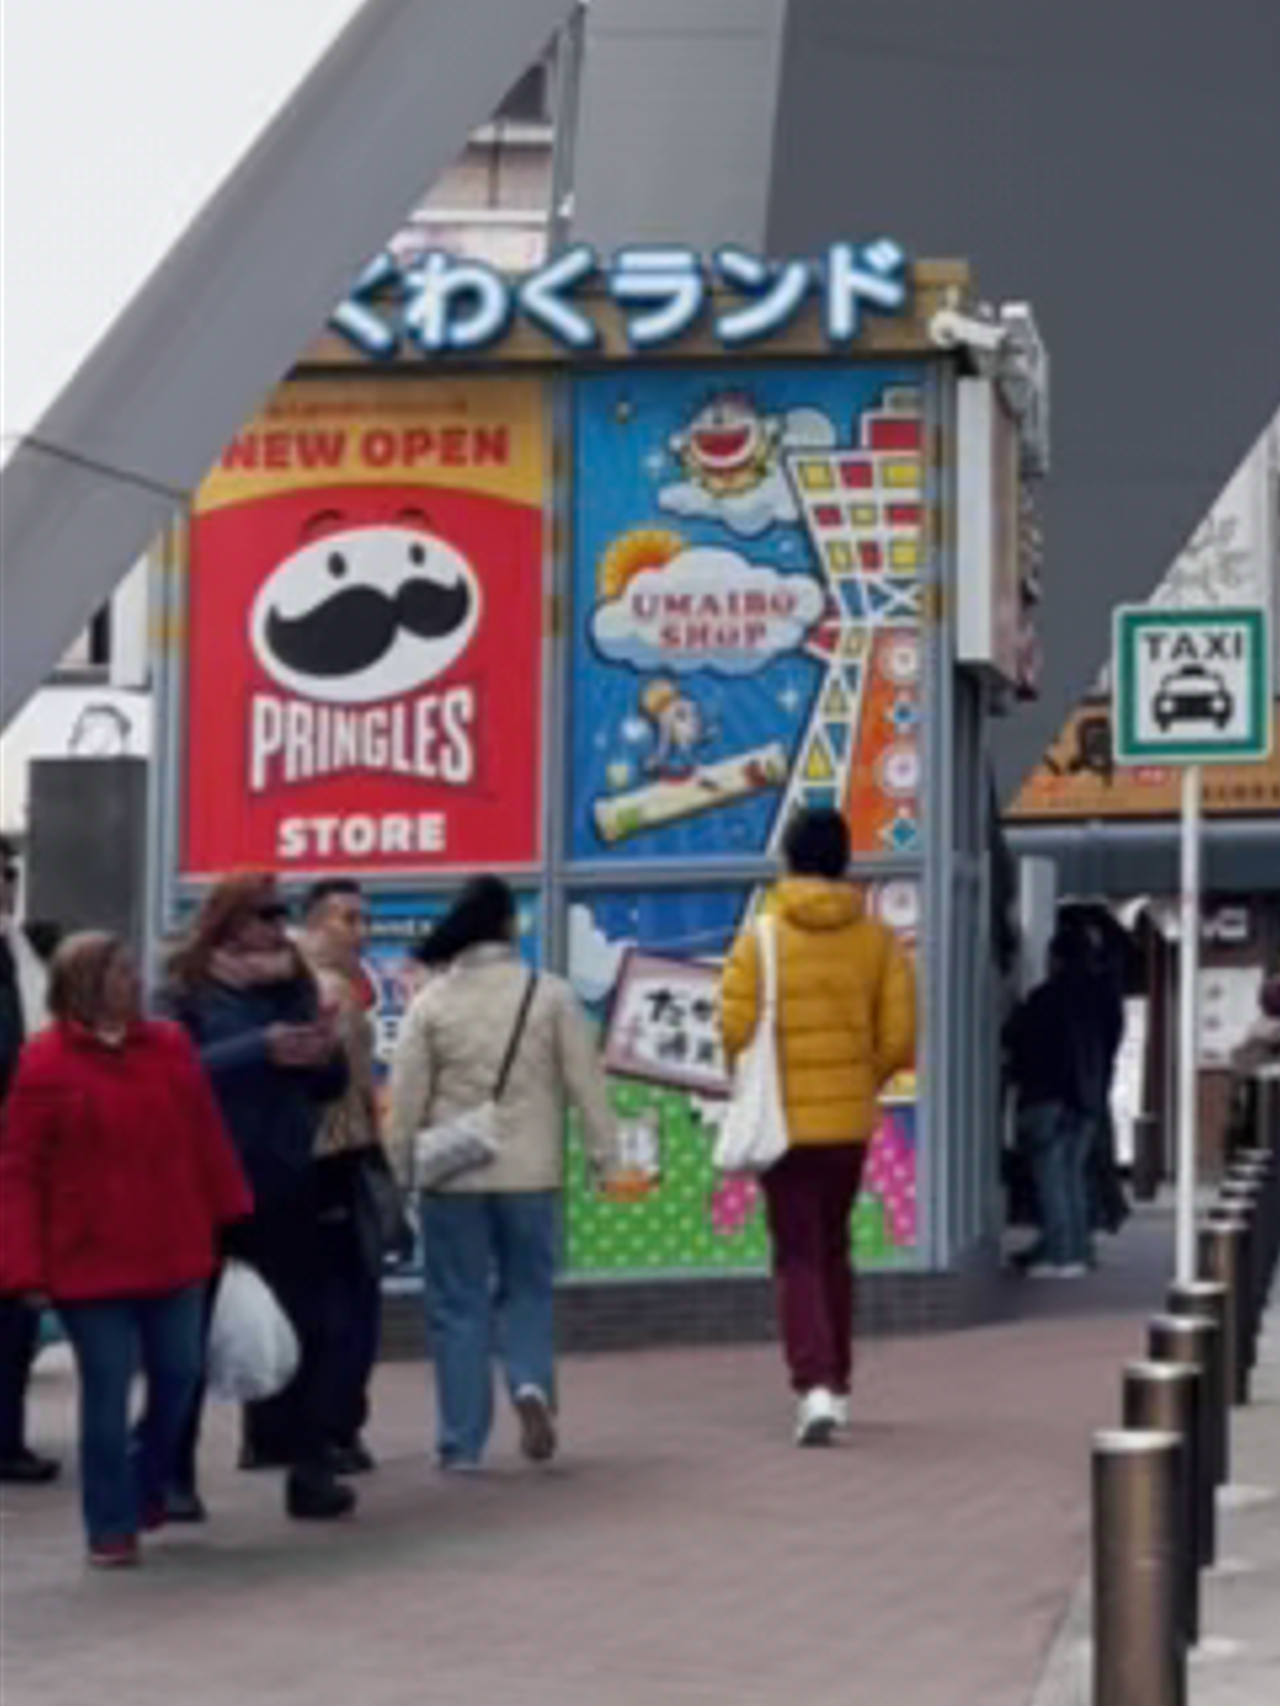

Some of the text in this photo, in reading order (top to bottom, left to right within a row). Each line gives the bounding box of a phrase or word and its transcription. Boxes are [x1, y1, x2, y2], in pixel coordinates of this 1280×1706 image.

[358, 423, 511, 469] OPEN
[658, 621, 769, 650] SHOP
[1142, 630, 1244, 663] TAXI
[249, 684, 475, 792] PRINGLES
[275, 811, 448, 857] STORE
